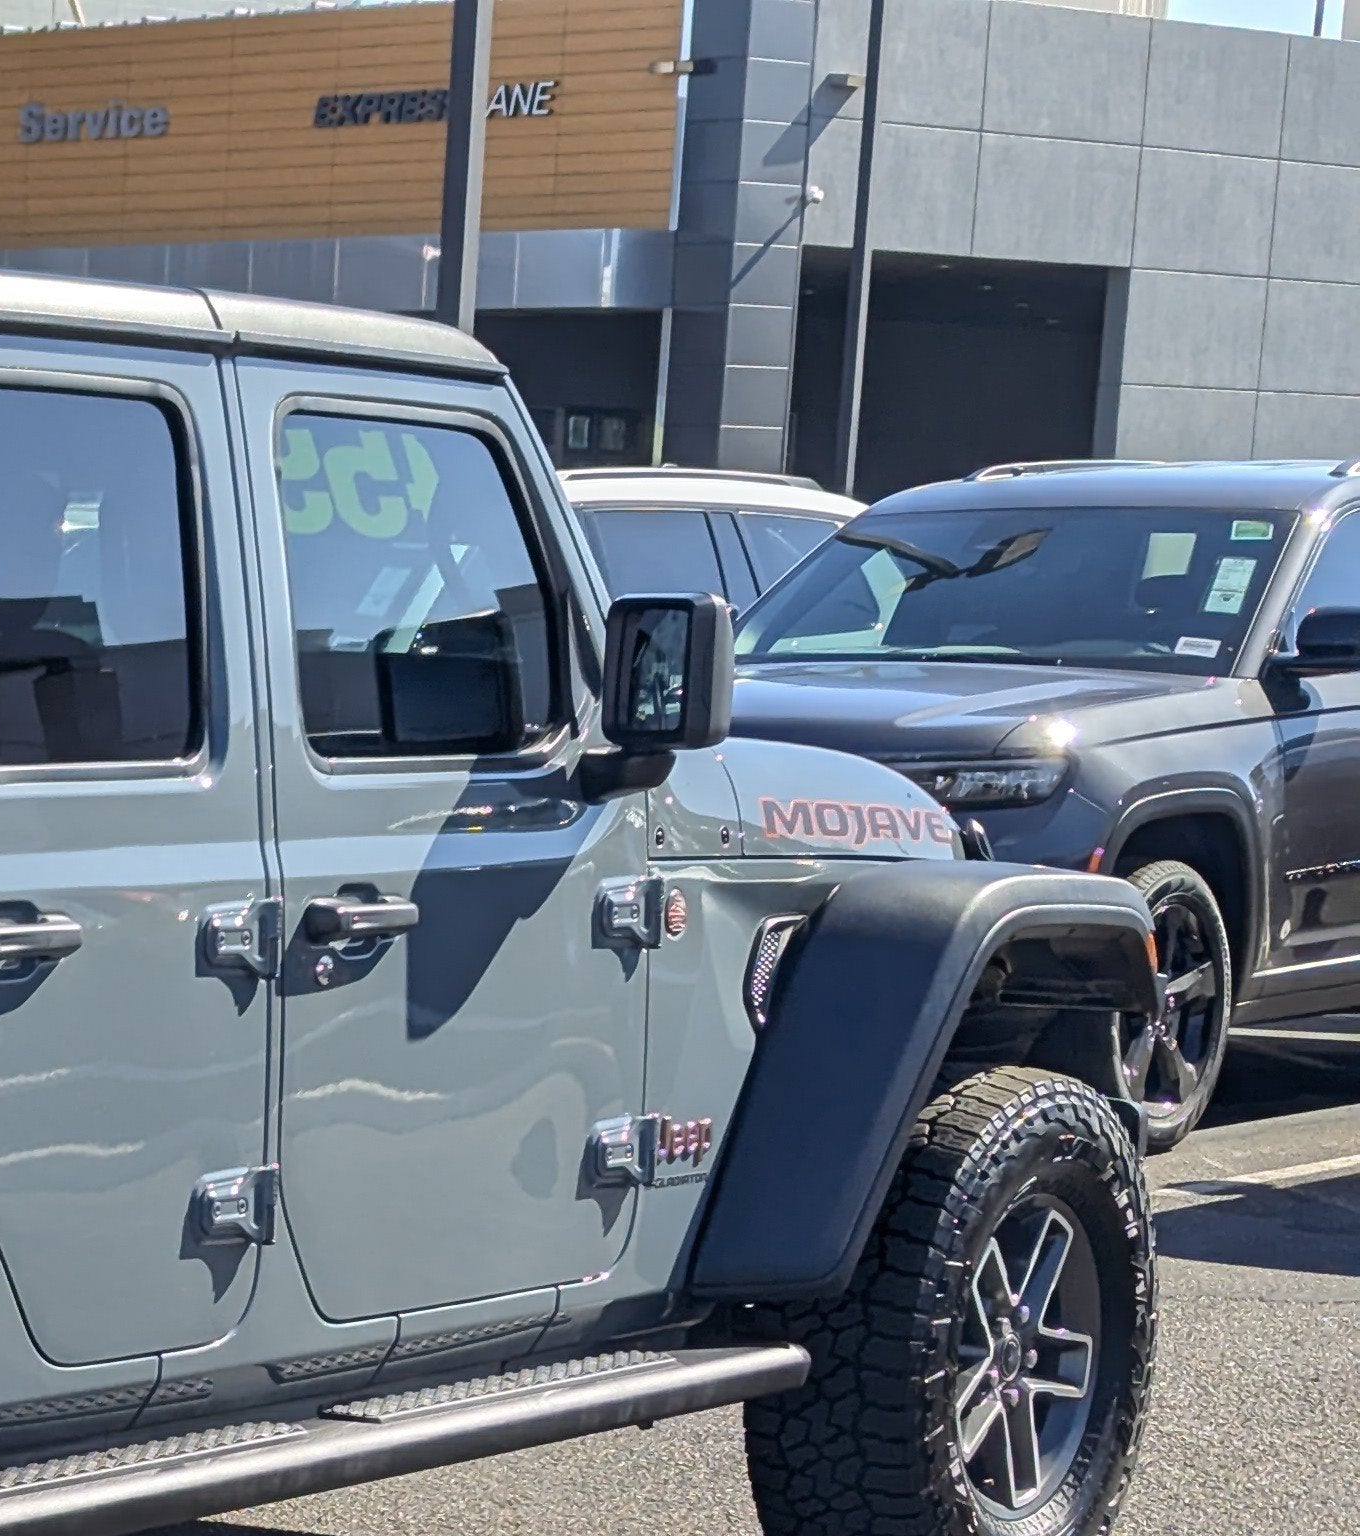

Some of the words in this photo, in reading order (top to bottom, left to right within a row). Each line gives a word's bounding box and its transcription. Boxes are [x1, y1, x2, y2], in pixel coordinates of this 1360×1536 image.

[19, 99, 170, 144] Service
[486, 81, 560, 118] ANE
[757, 796, 952, 850] MOJAVE
